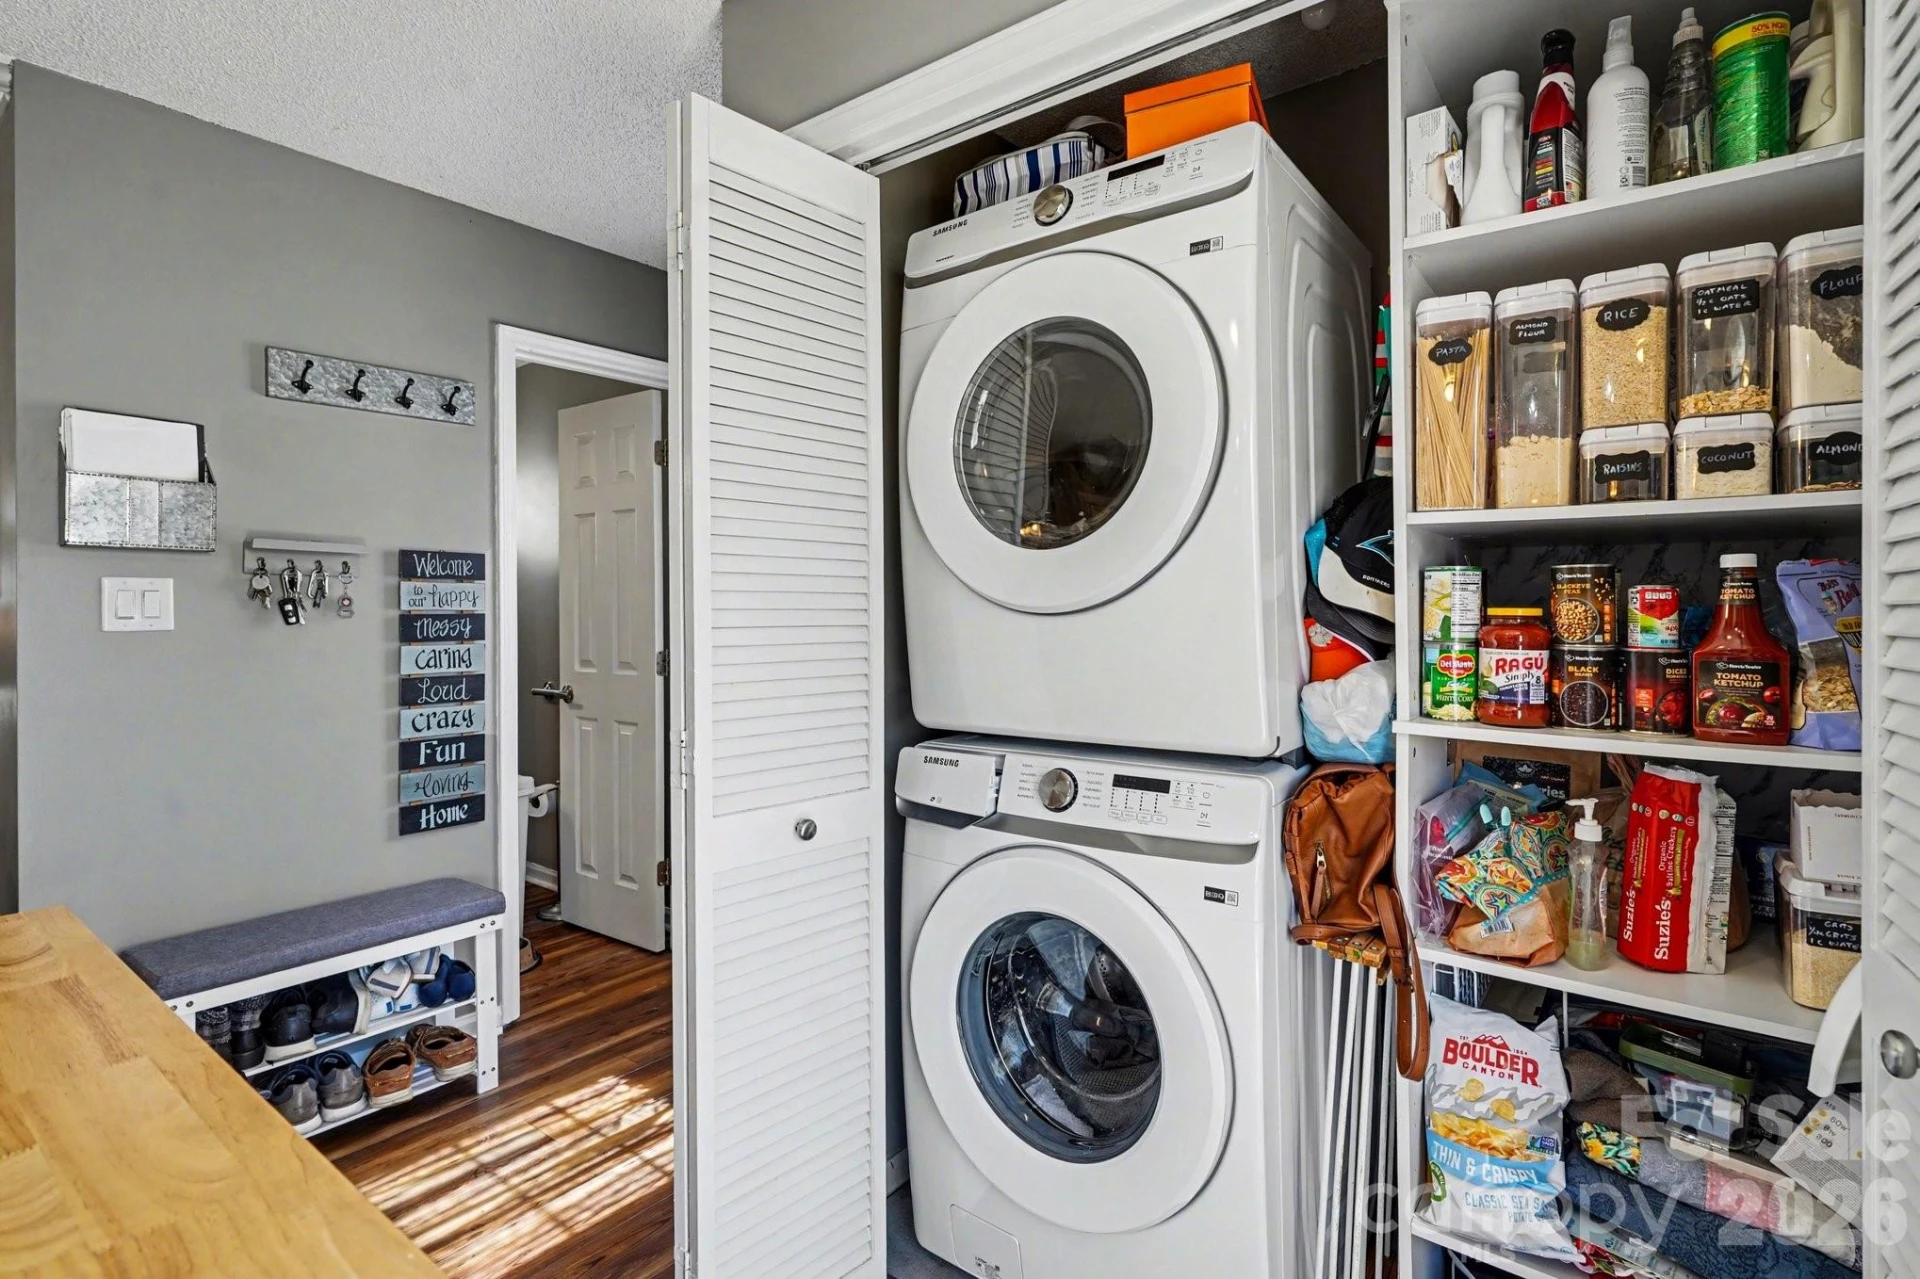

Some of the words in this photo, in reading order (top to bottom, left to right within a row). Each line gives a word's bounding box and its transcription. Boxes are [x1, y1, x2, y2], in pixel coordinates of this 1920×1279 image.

[933, 219, 968, 237] SAMSUNG
[1697, 284, 1748, 296] OATMEAL
[1720, 294, 1746, 302] OATS
[1713, 300, 1752, 311] WATER
[1603, 306, 1639, 323] RICE
[1515, 321, 1549, 330] ALMOND
[1518, 329, 1546, 338] FLOUR
[1436, 345, 1467, 358] PASTA
[1701, 451, 1754, 464] COCONUT
[1603, 462, 1643, 475] RAISINS
[413, 553, 474, 577] Welcome
[408, 596, 426, 608] our
[428, 584, 479, 608] happy
[413, 585, 423, 596] to
[1495, 652, 1545, 676] RAGÚ
[1567, 665, 1599, 673] BLACK
[1505, 670, 1535, 683] Simply
[1535, 676, 1541, 684] 8
[1713, 679, 1764, 688] KETCHUP
[1716, 672, 1762, 681] TOMATO
[417, 678, 471, 703] Loud
[419, 740, 466, 765] Fun
[923, 755, 959, 768] SAMSUNG
[420, 803, 469, 830] Home
[1667, 826, 1678, 859] Crackers
[1658, 841, 1667, 871] Organic
[1666, 860, 1674, 887] Saltine
[1623, 888, 1636, 943] Suzie's
[1654, 899, 1672, 960] Suzie's
[1828, 940, 1860, 950] WATE
[1442, 1038, 1540, 1088] BOULDER
[1462, 1061, 1514, 1080] CANYON
[1433, 1141, 1462, 1170] THIN
[1466, 1157, 1477, 1176] &
[1482, 1162, 1540, 1185] CRISPY
[1465, 1191, 1508, 1210] CLASSIC
[1512, 1195, 1530, 1210] SEA
